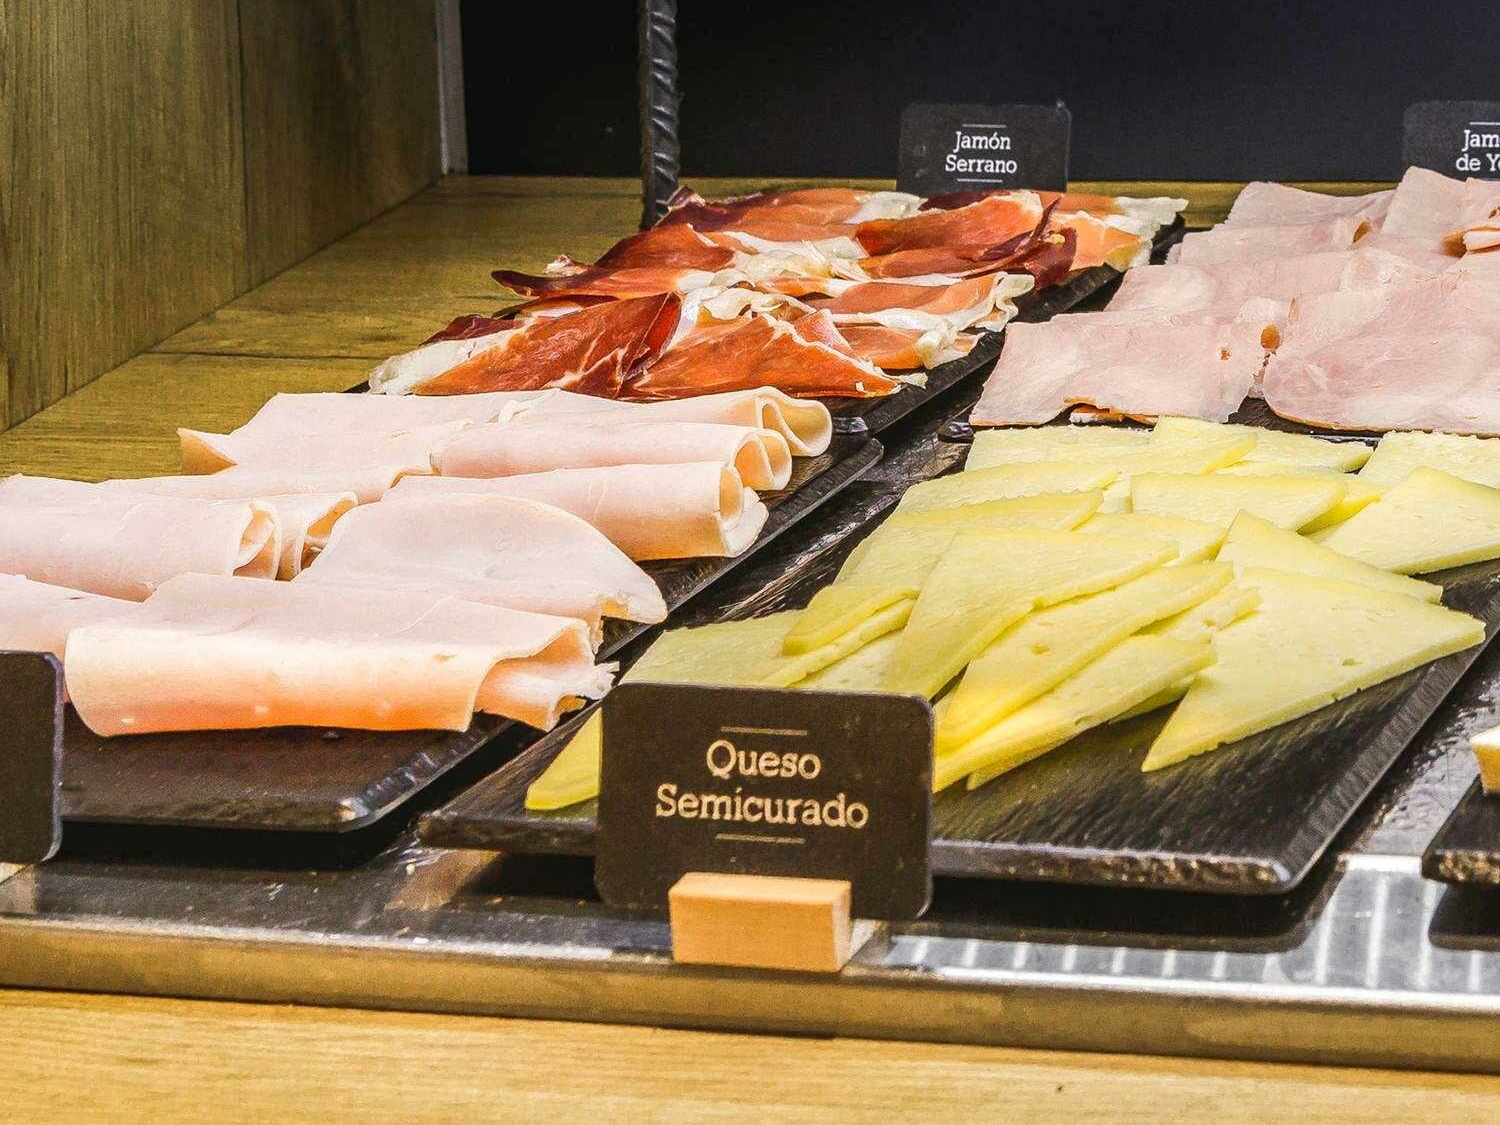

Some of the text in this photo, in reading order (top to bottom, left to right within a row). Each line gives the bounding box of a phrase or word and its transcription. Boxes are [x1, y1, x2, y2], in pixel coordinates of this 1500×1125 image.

[953, 130, 1011, 152] Jamón
[945, 153, 1018, 174] Serrano
[1455, 153, 1481, 172] de
[706, 739, 822, 780] Queso
